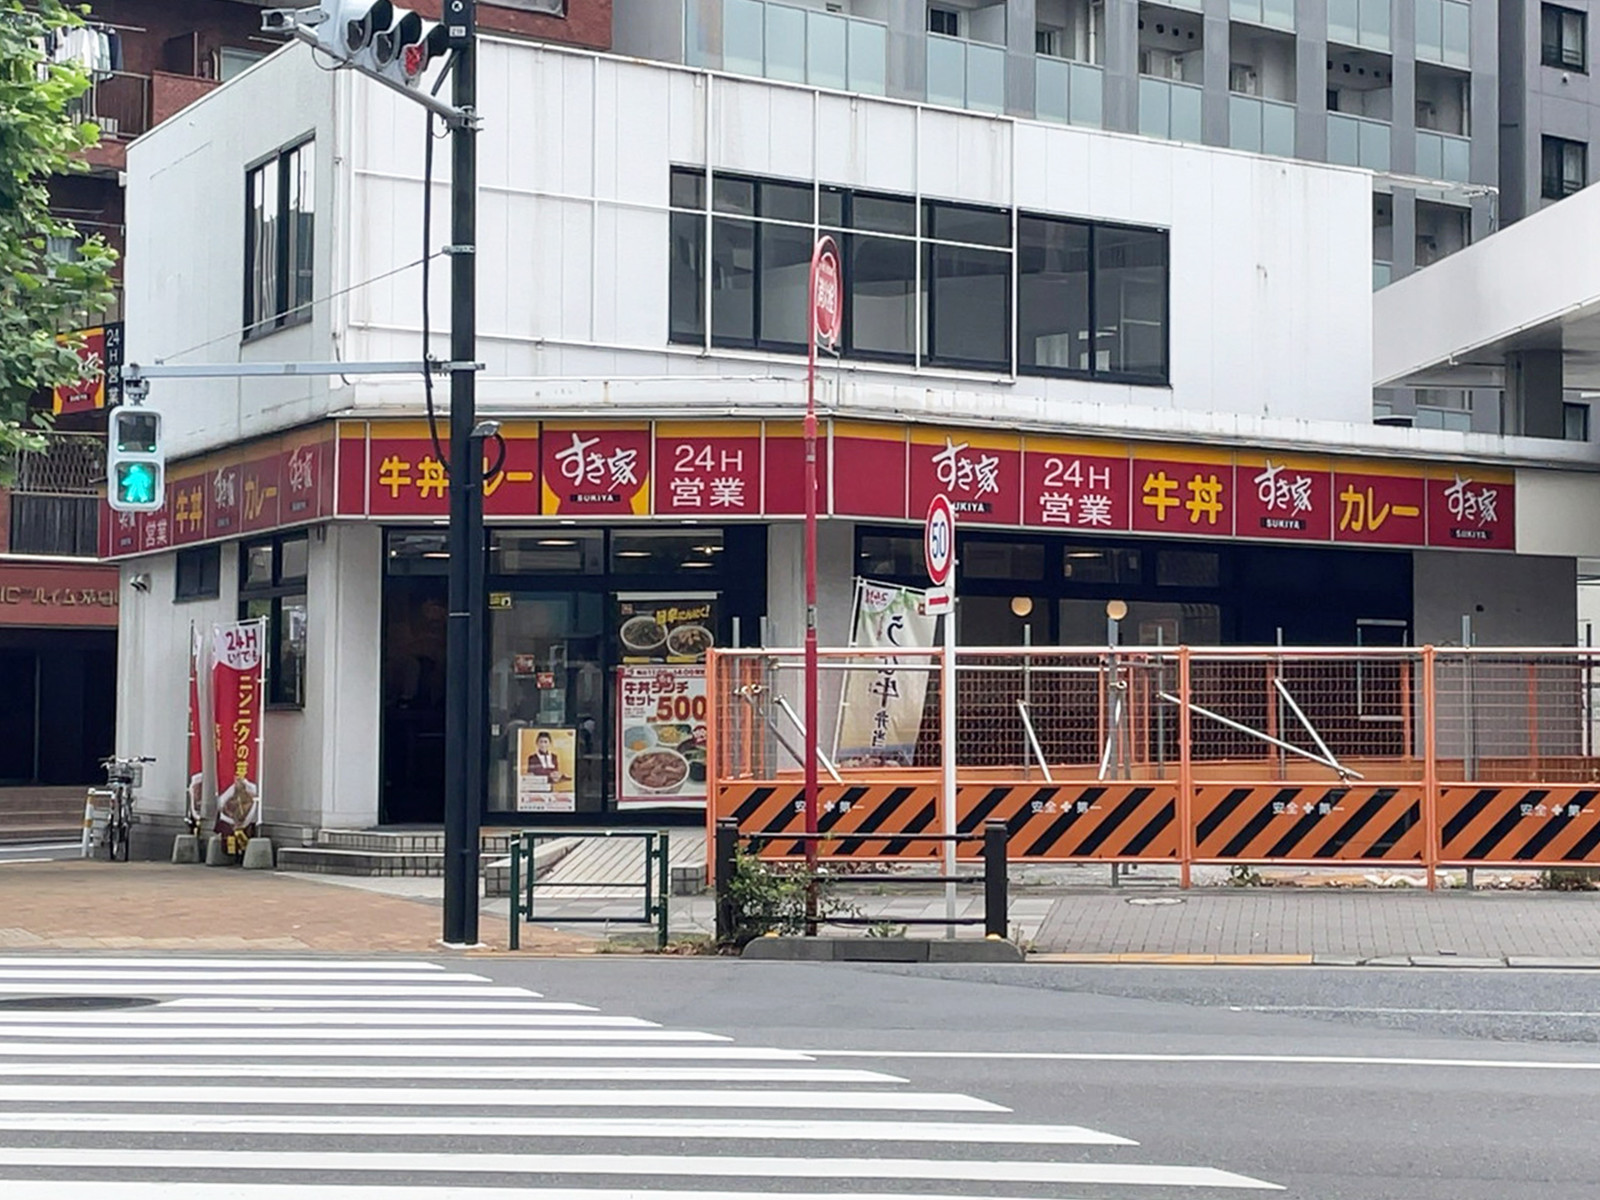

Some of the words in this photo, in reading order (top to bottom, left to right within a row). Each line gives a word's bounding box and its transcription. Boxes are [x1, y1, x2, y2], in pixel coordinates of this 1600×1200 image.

[555, 433, 637, 492] すき家
[674, 444, 743, 472] 24H
[931, 436, 999, 500] すき家
[1043, 457, 1110, 490] 24H
[577, 494, 614, 502] SUKIYA
[670, 477, 745, 507] 営業
[1142, 471, 1224, 525] 牛丼
[1254, 459, 1313, 517] すき家
[1443, 473, 1498, 528] すき家
[951, 502, 985, 513] UKIYA
[1039, 492, 1113, 526] 営業
[1266, 518, 1300, 530] SUKIYA
[1339, 483, 1420, 532] カレー
[932, 521, 946, 559] 50
[225, 628, 258, 650] 24H
[656, 695, 707, 721] 500
